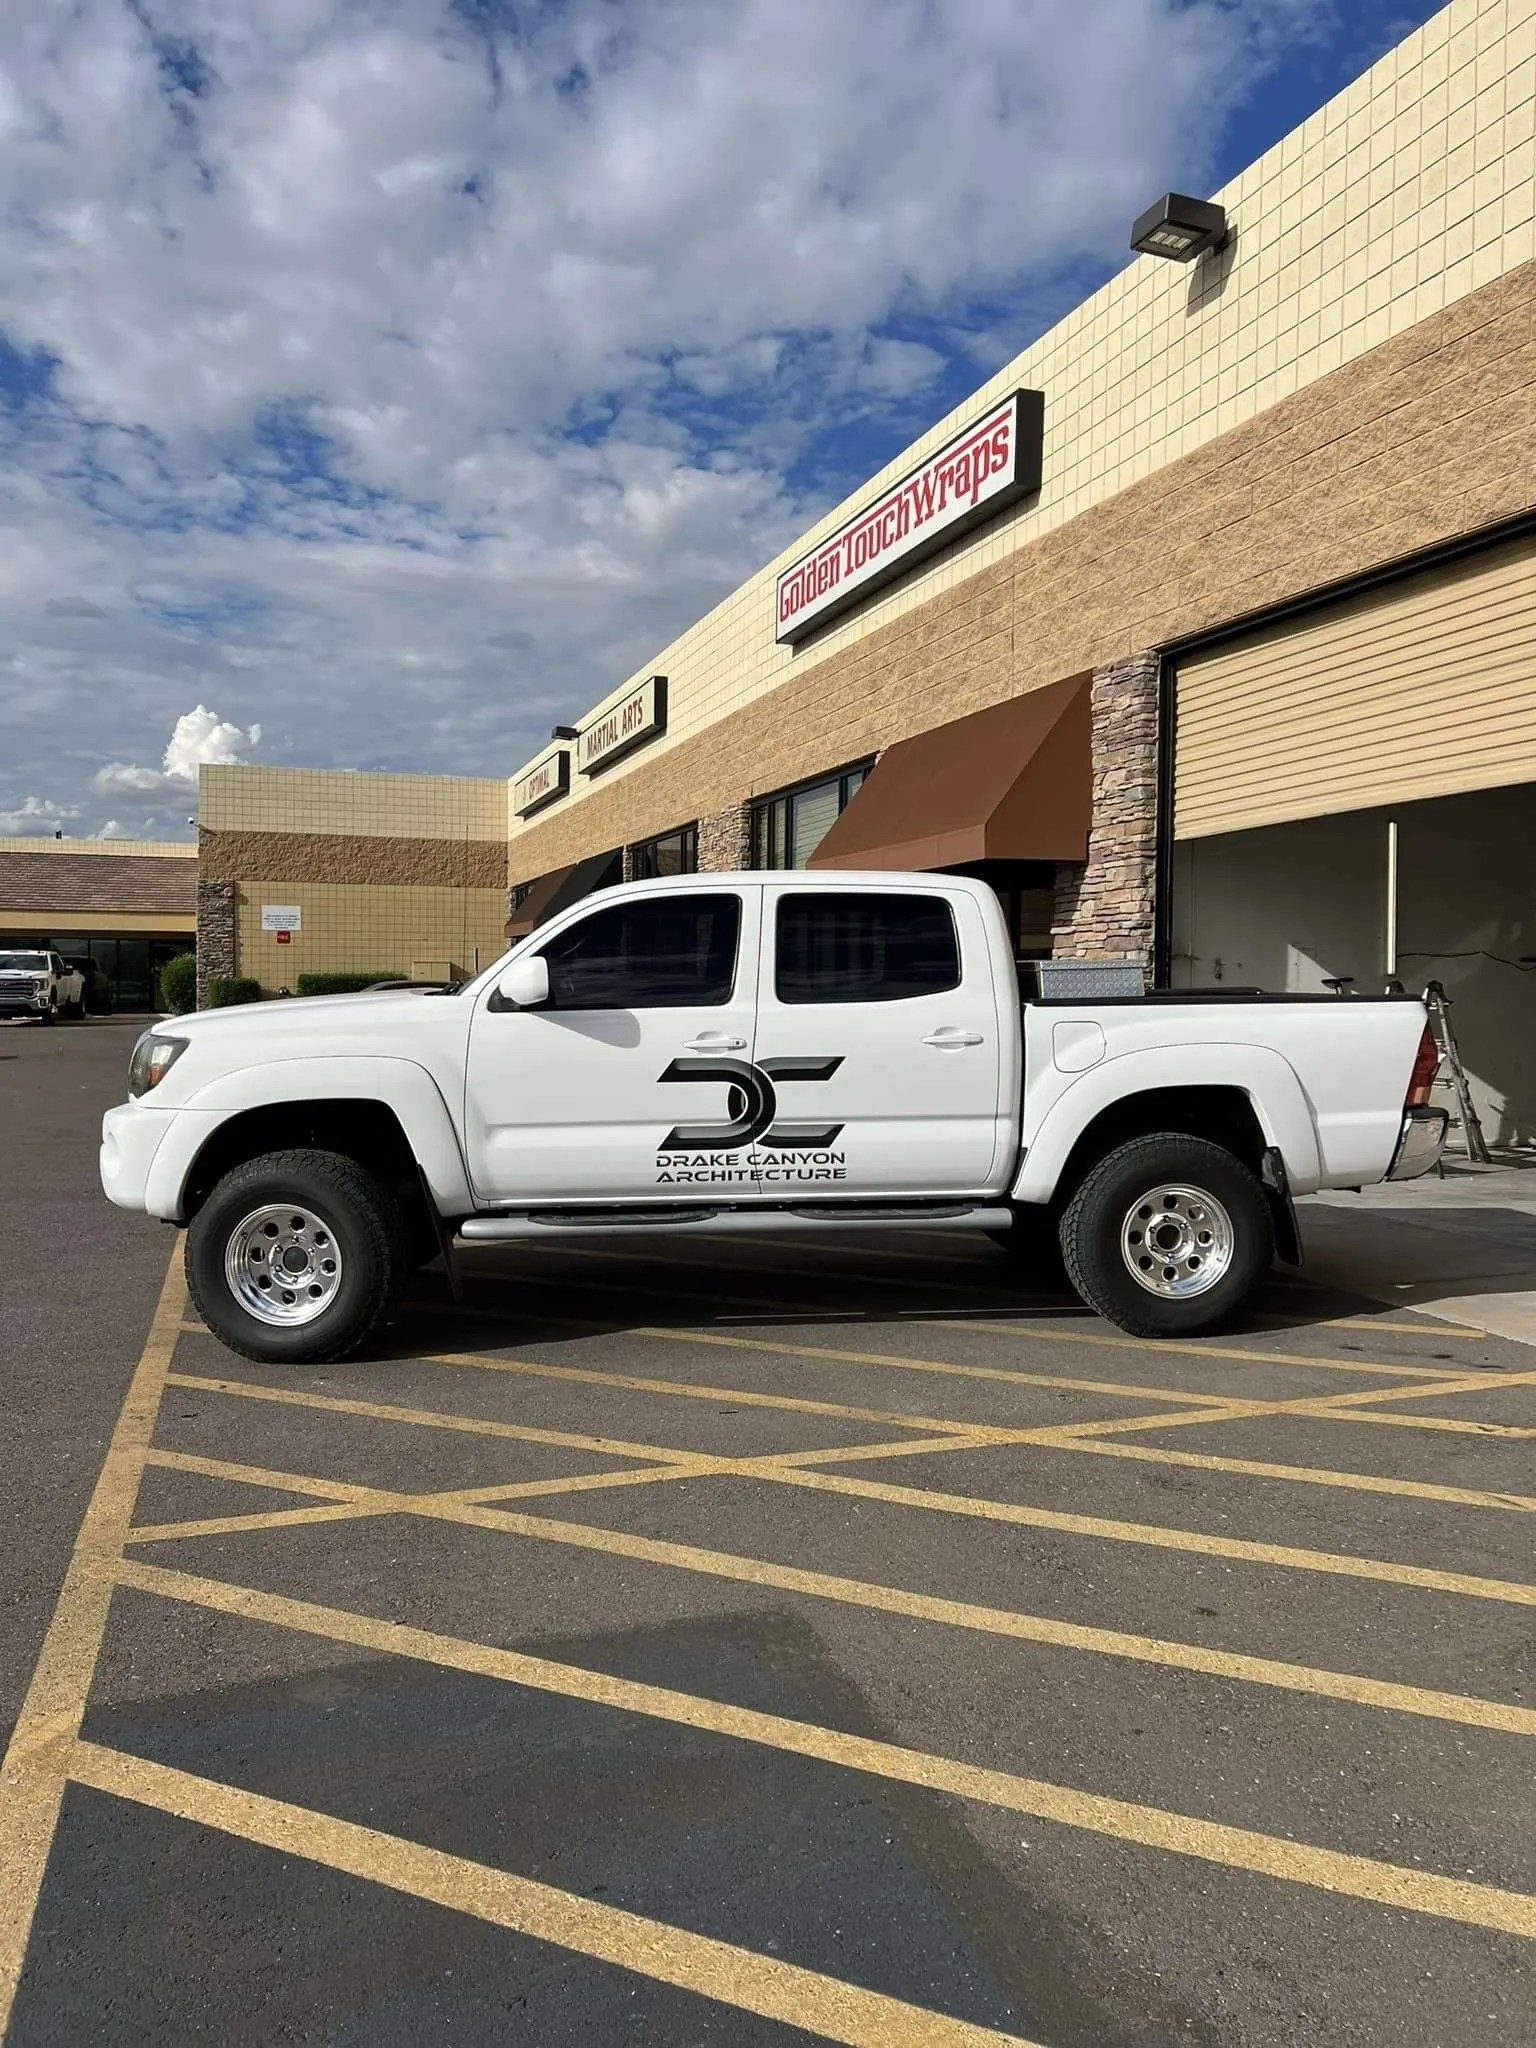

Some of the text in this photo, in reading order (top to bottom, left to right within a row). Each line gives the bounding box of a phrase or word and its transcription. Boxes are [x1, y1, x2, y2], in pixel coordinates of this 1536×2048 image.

[780, 538, 842, 623] Golden
[587, 696, 643, 760] MARTIAL ARTS
[656, 1152, 846, 1167] DRAKE CANYON
[656, 1168, 847, 1182] ARCHITECTURE
